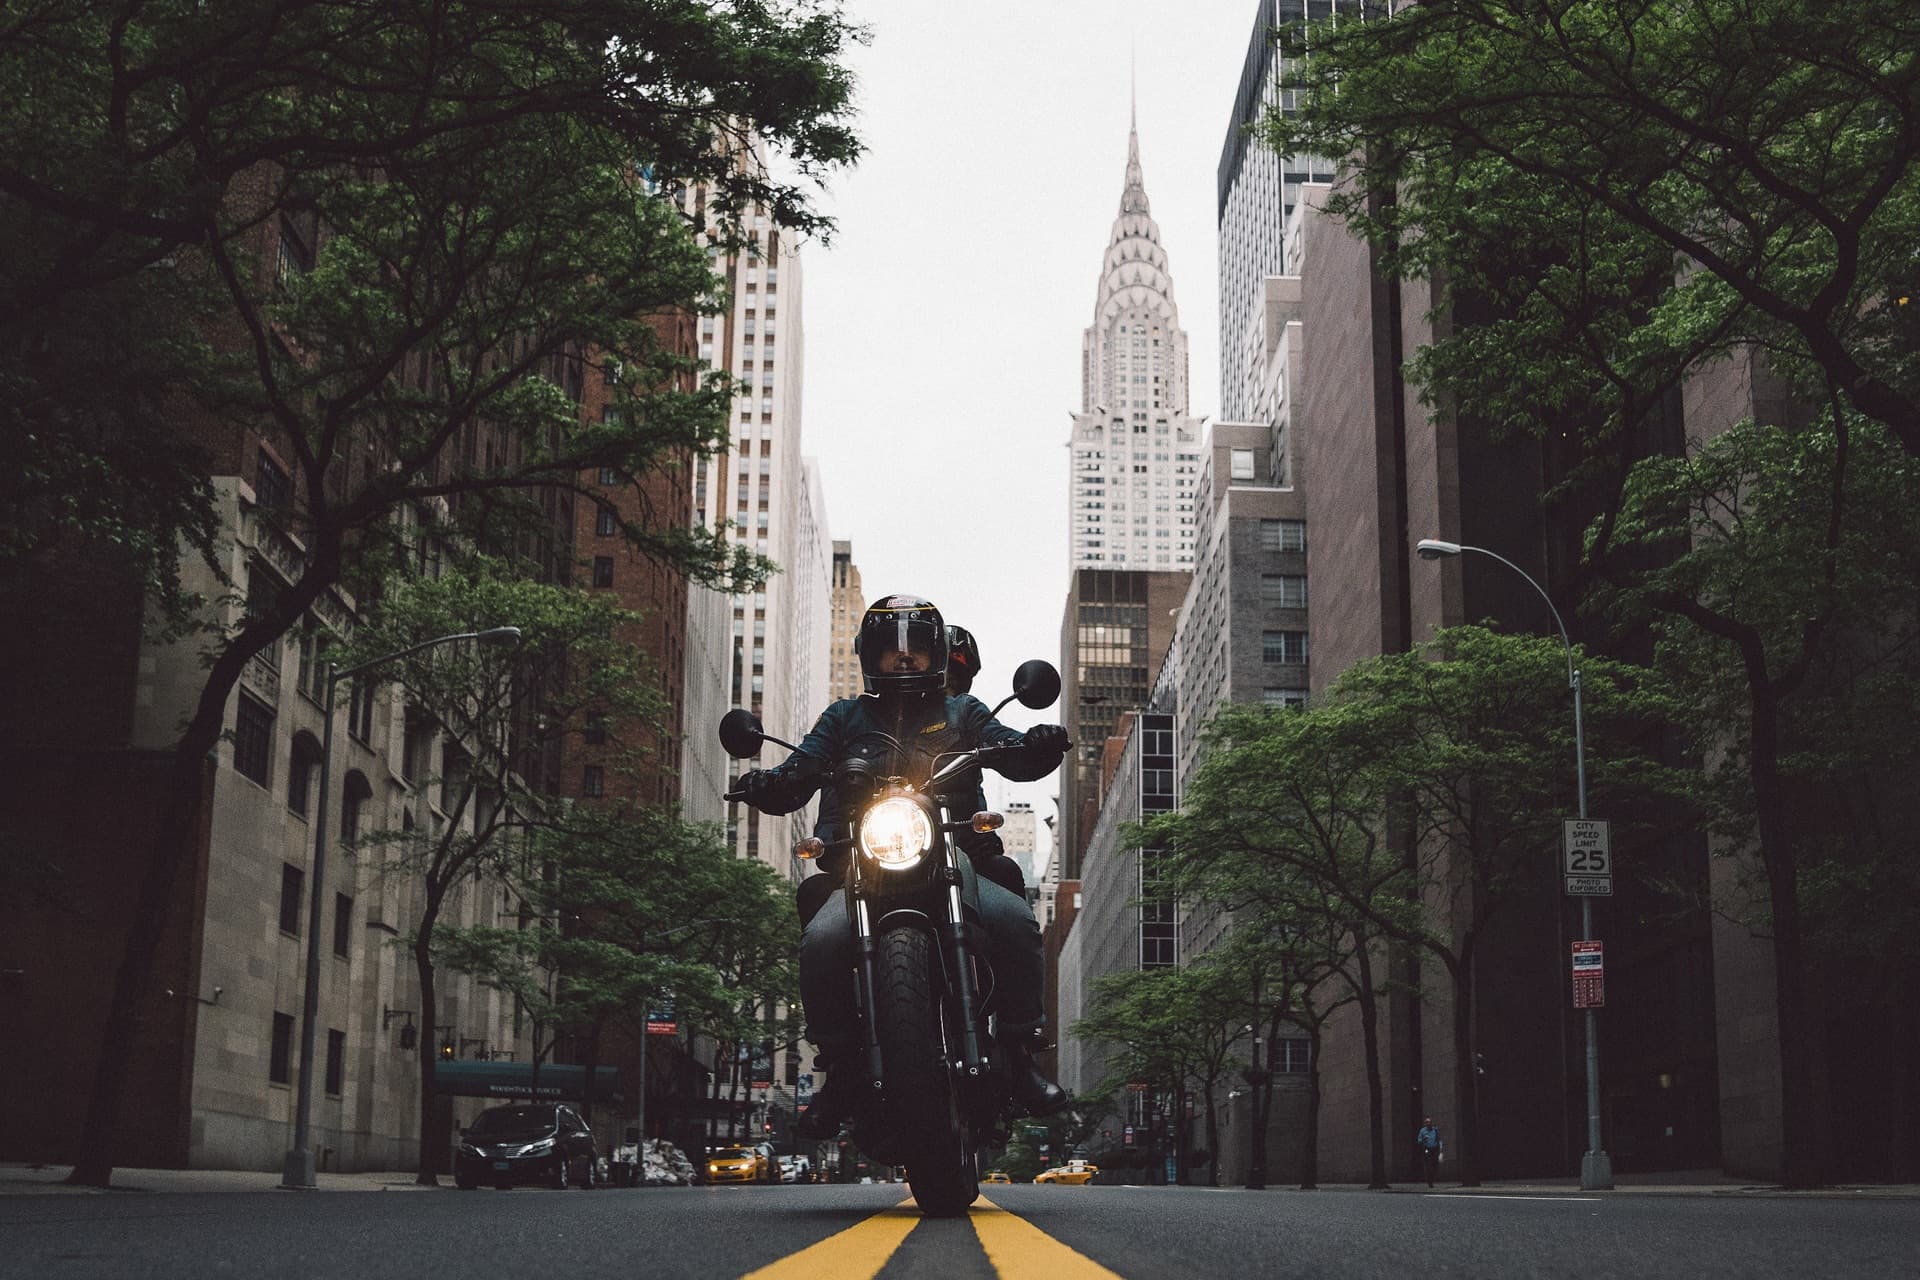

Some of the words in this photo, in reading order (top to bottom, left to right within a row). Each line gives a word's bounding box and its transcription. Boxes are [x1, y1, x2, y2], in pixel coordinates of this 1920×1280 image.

[1572, 831, 1600, 839] SPEED
[1575, 839, 1597, 847] LIMIT
[1571, 849, 1605, 871] 25
